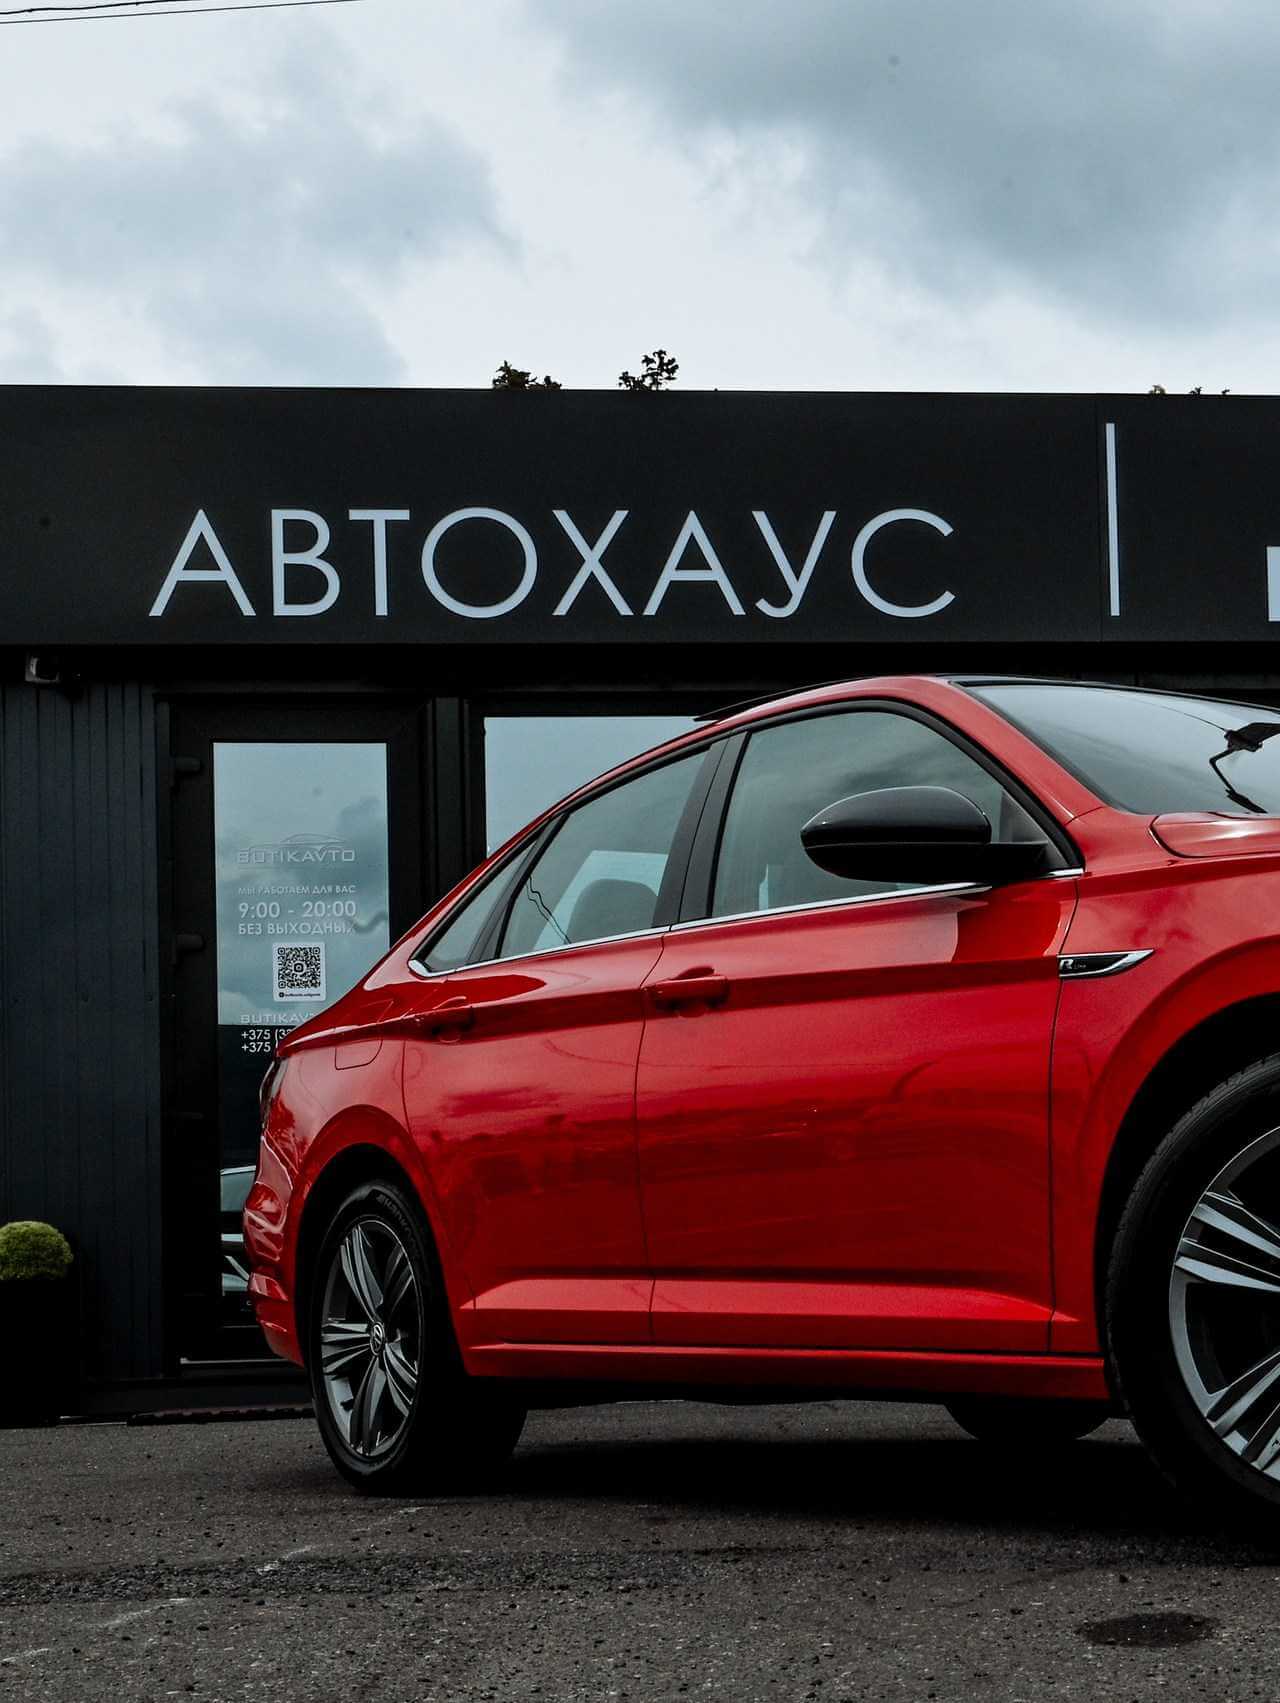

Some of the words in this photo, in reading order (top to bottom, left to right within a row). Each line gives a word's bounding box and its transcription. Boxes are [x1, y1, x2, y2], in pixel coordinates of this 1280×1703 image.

[149, 507, 956, 619] АВТОХАУС
[238, 849, 356, 863] BUTIKAVTO
[335, 884, 357, 894] ВАС
[238, 902, 281, 919] 9:00
[302, 901, 356, 918] 20:00
[238, 923, 262, 935] БЕЗ
[240, 1013, 313, 1024] BUTIKAV
[241, 1029, 271, 1040] +375
[241, 1041, 271, 1053] +375
